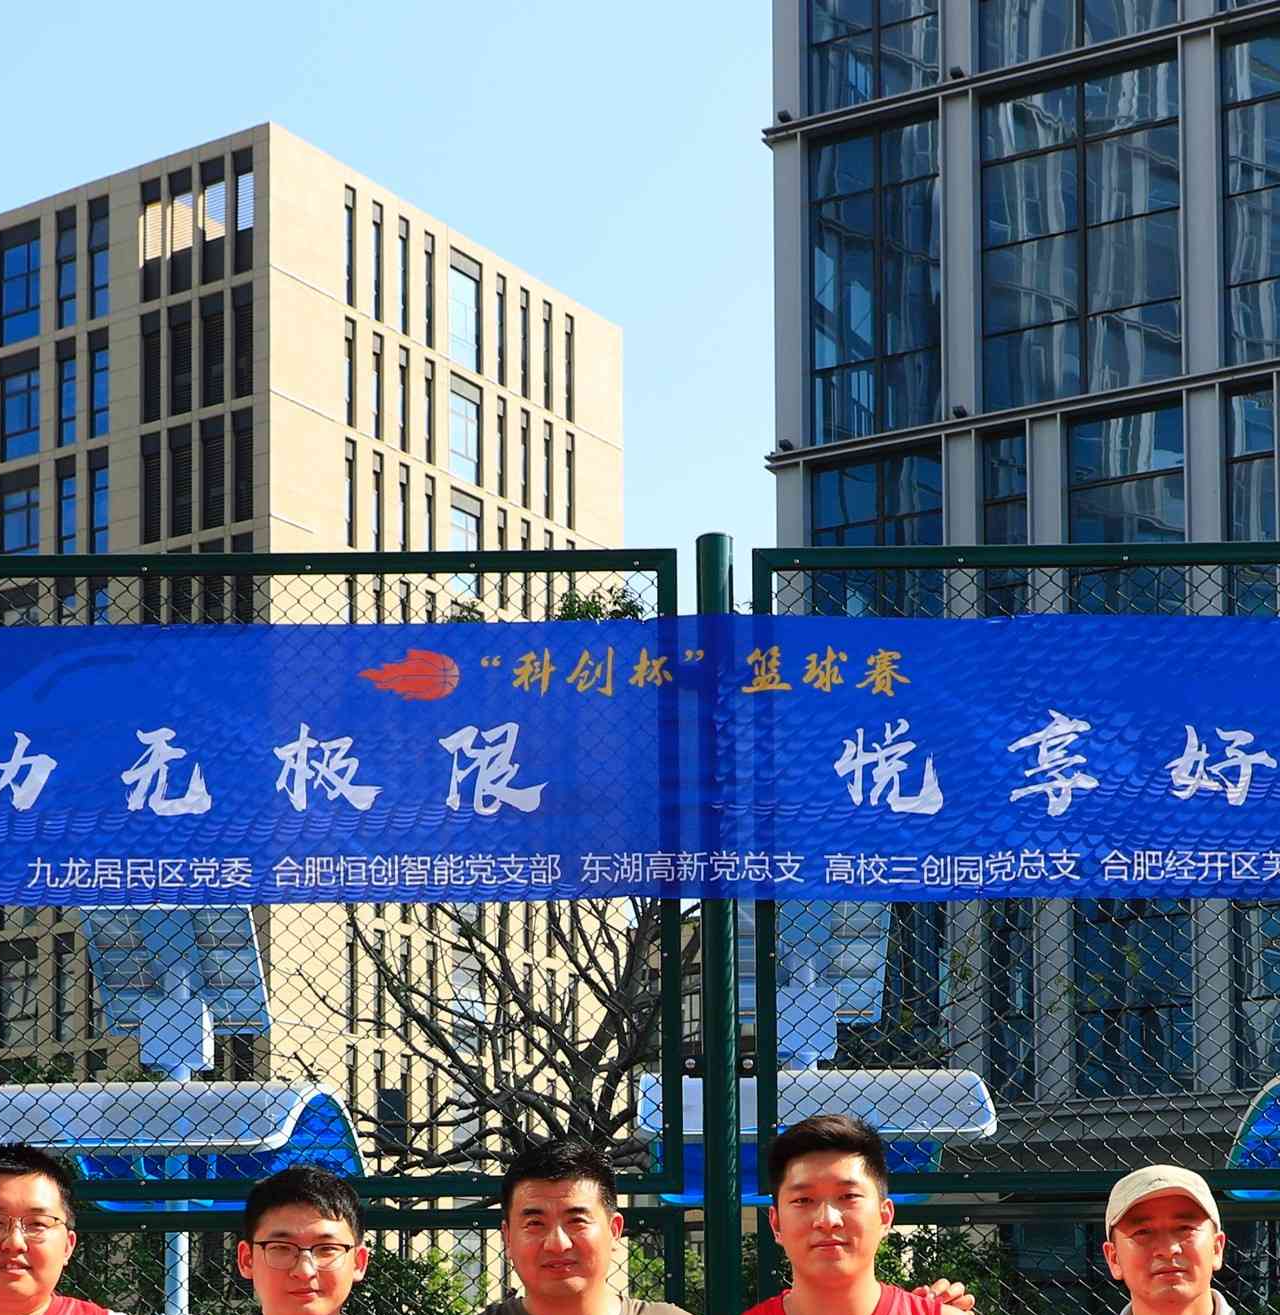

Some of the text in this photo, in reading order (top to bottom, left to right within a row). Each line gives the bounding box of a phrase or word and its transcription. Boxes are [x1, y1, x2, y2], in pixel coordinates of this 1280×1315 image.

[26, 856, 251, 889] 九龙居民区党委
[271, 854, 562, 888] 合肥恒创智能党支部
[580, 850, 805, 885] 东湖高新党总支
[823, 849, 1081, 887] 高校三创园党总支
